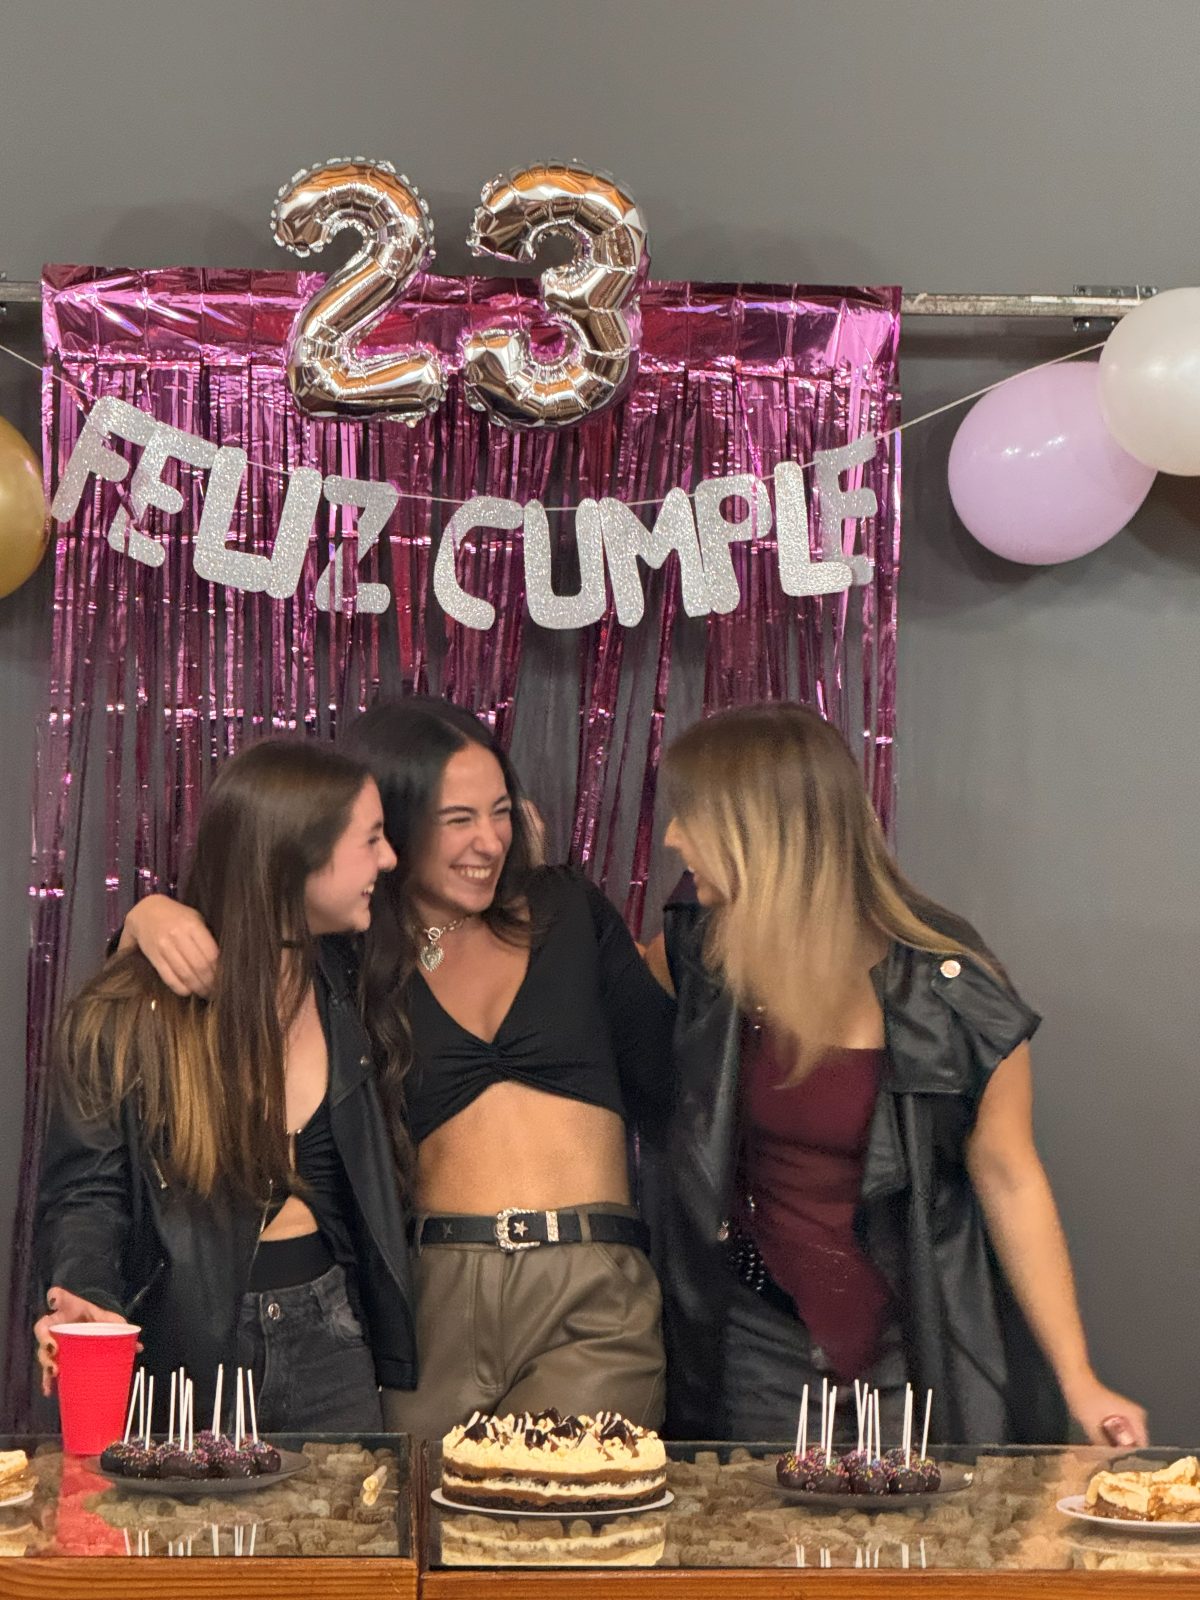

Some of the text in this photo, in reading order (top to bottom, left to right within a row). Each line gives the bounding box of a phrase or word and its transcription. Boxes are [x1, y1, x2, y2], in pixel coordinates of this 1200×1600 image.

[271, 155, 649, 430] 23
[51, 395, 878, 631] FELIZ CUMPLE
